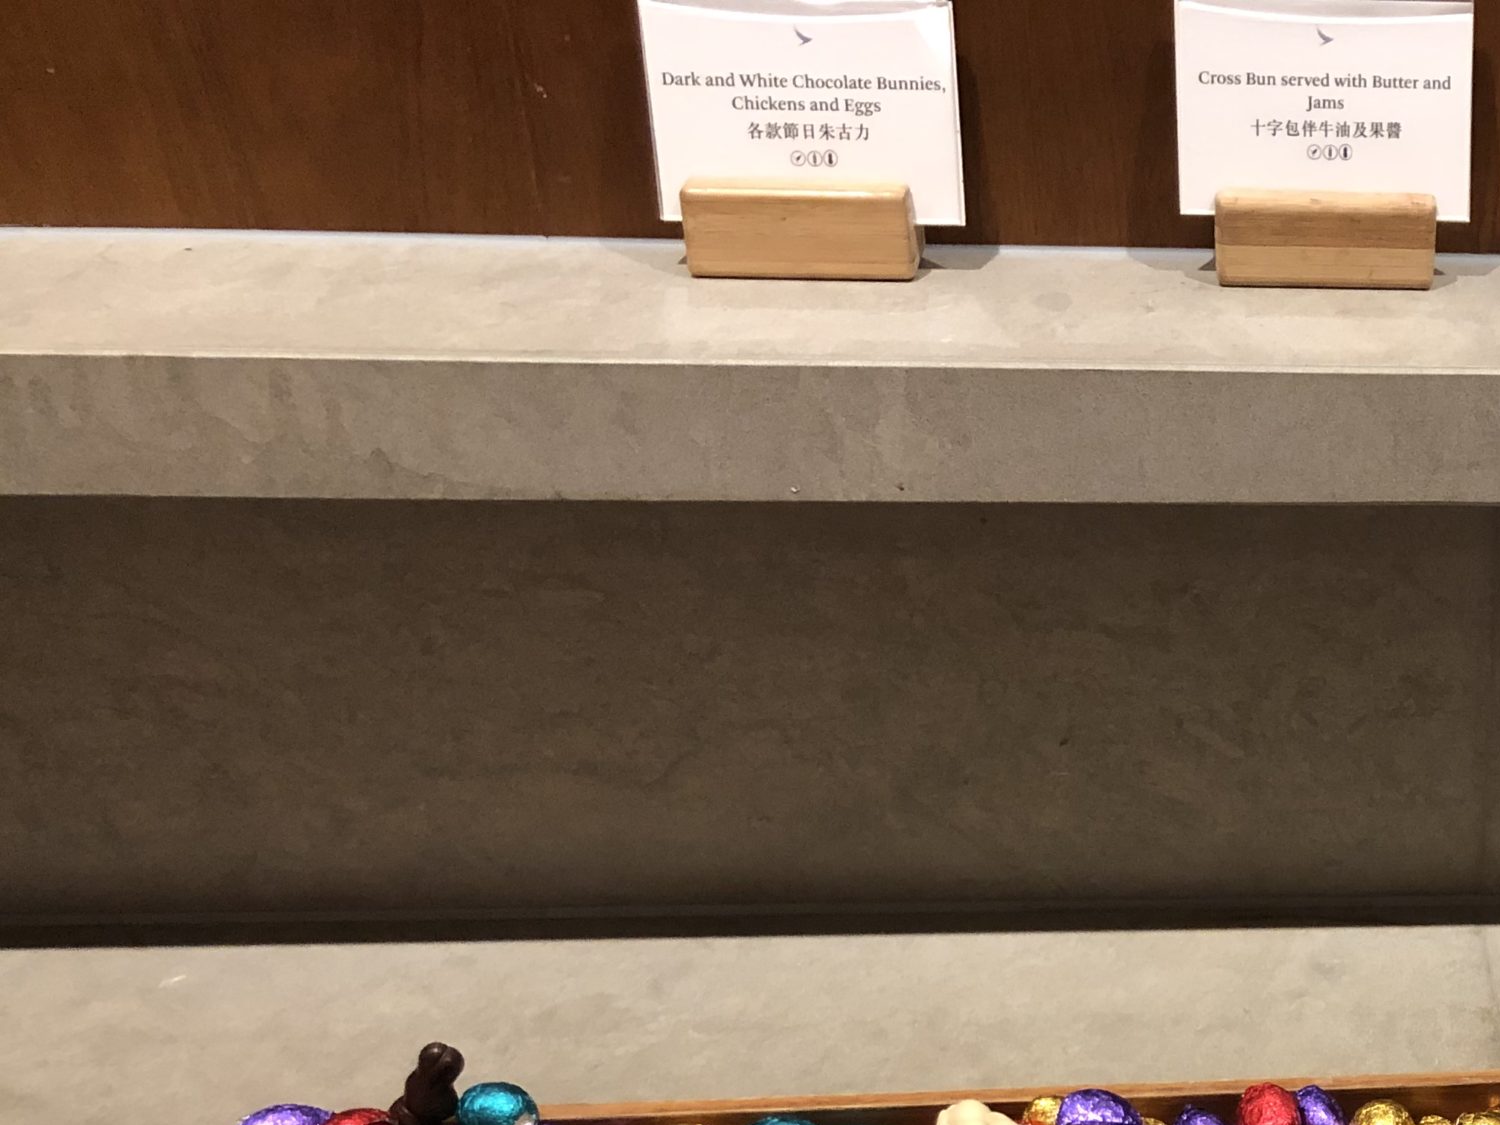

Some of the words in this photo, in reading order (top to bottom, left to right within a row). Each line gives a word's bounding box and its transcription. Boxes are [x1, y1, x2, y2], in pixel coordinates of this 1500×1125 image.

[661, 72, 701, 87] Dark
[705, 73, 735, 88] and
[739, 73, 788, 89] White
[792, 74, 872, 91] Chocolate
[876, 76, 947, 93] Bunnies,
[1198, 71, 1242, 86] Cross
[1246, 72, 1277, 87] Bun
[1280, 73, 1330, 88] served
[1334, 74, 1368, 89] with
[1372, 75, 1420, 90] Butter
[1423, 76, 1452, 91] and
[732, 96, 806, 111] Chickens
[809, 98, 840, 112] and
[844, 99, 882, 116] Eggs
[1306, 96, 1345, 112] Jams
[748, 121, 870, 141] 各款節日朱古力
